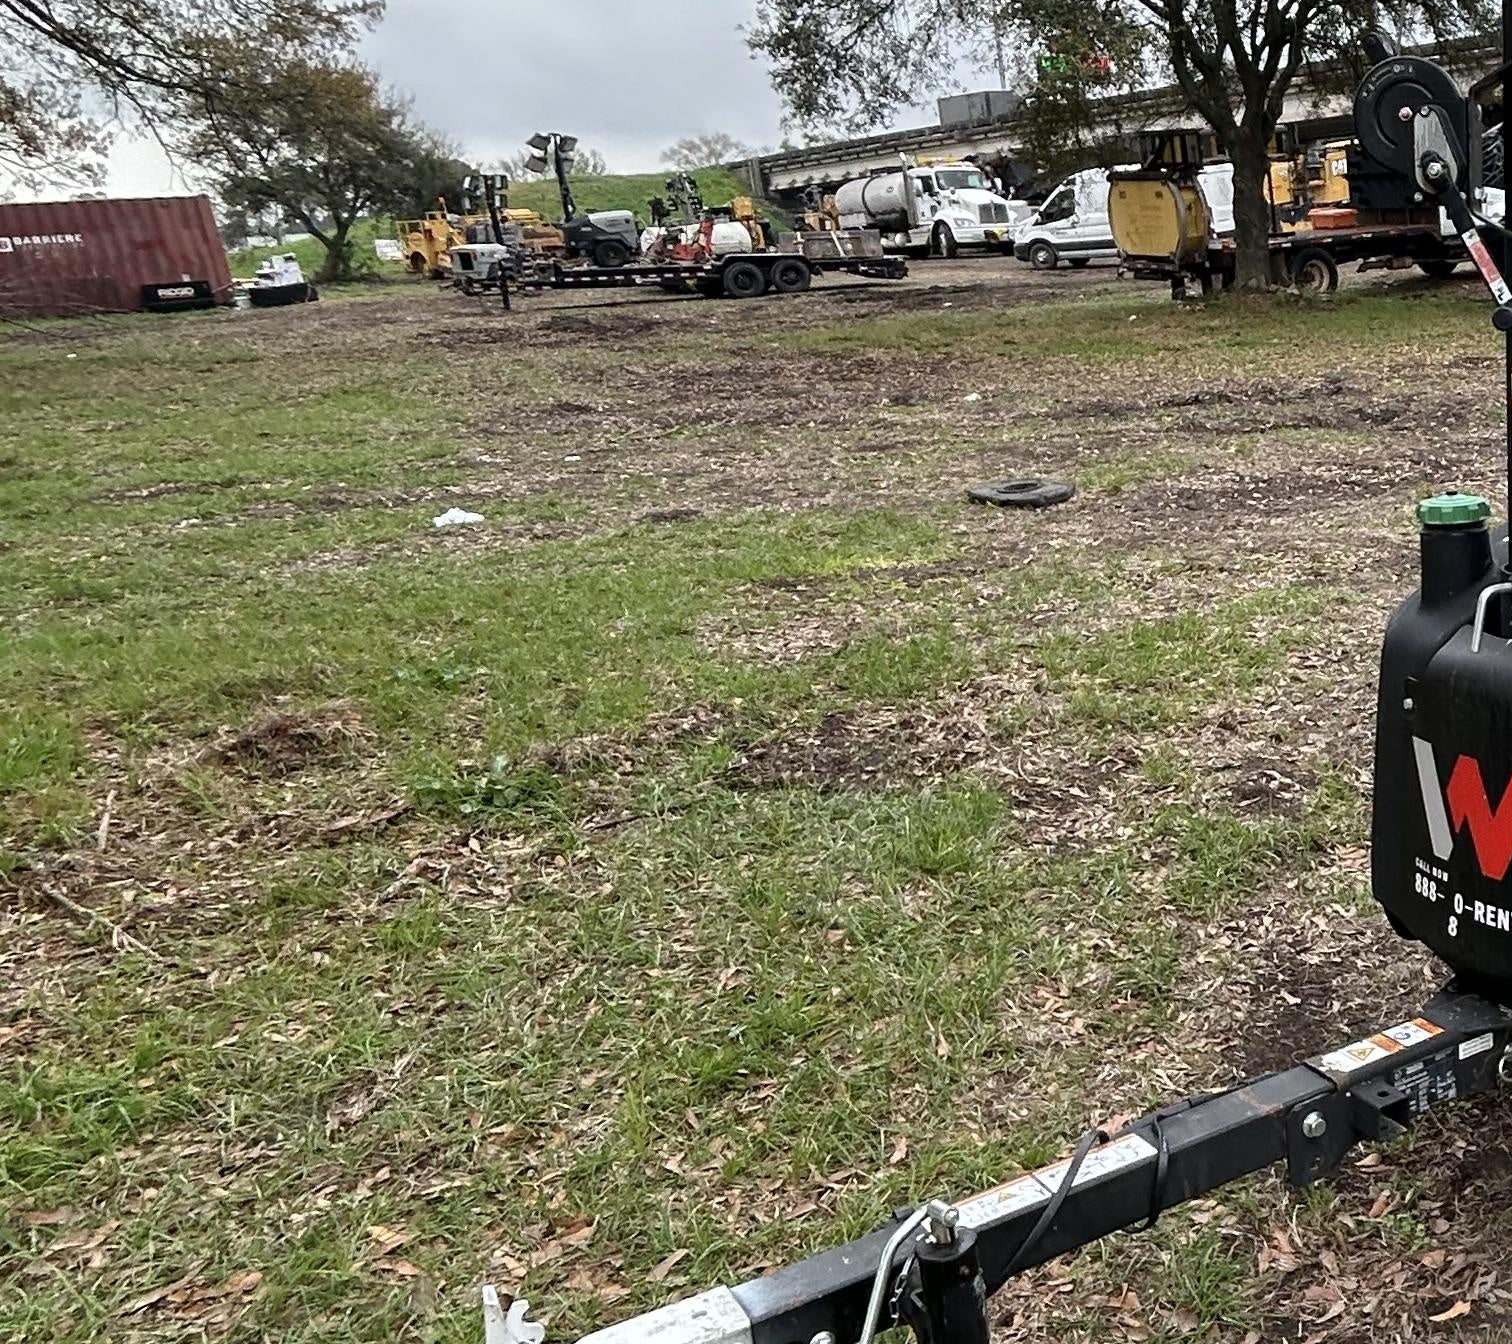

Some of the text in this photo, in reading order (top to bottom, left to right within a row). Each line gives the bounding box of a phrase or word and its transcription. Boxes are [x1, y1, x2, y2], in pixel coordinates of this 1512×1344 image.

[1415, 856, 1448, 882] CALL NOW
[1415, 872, 1445, 902] 888-
[1447, 915, 1458, 936] 8
